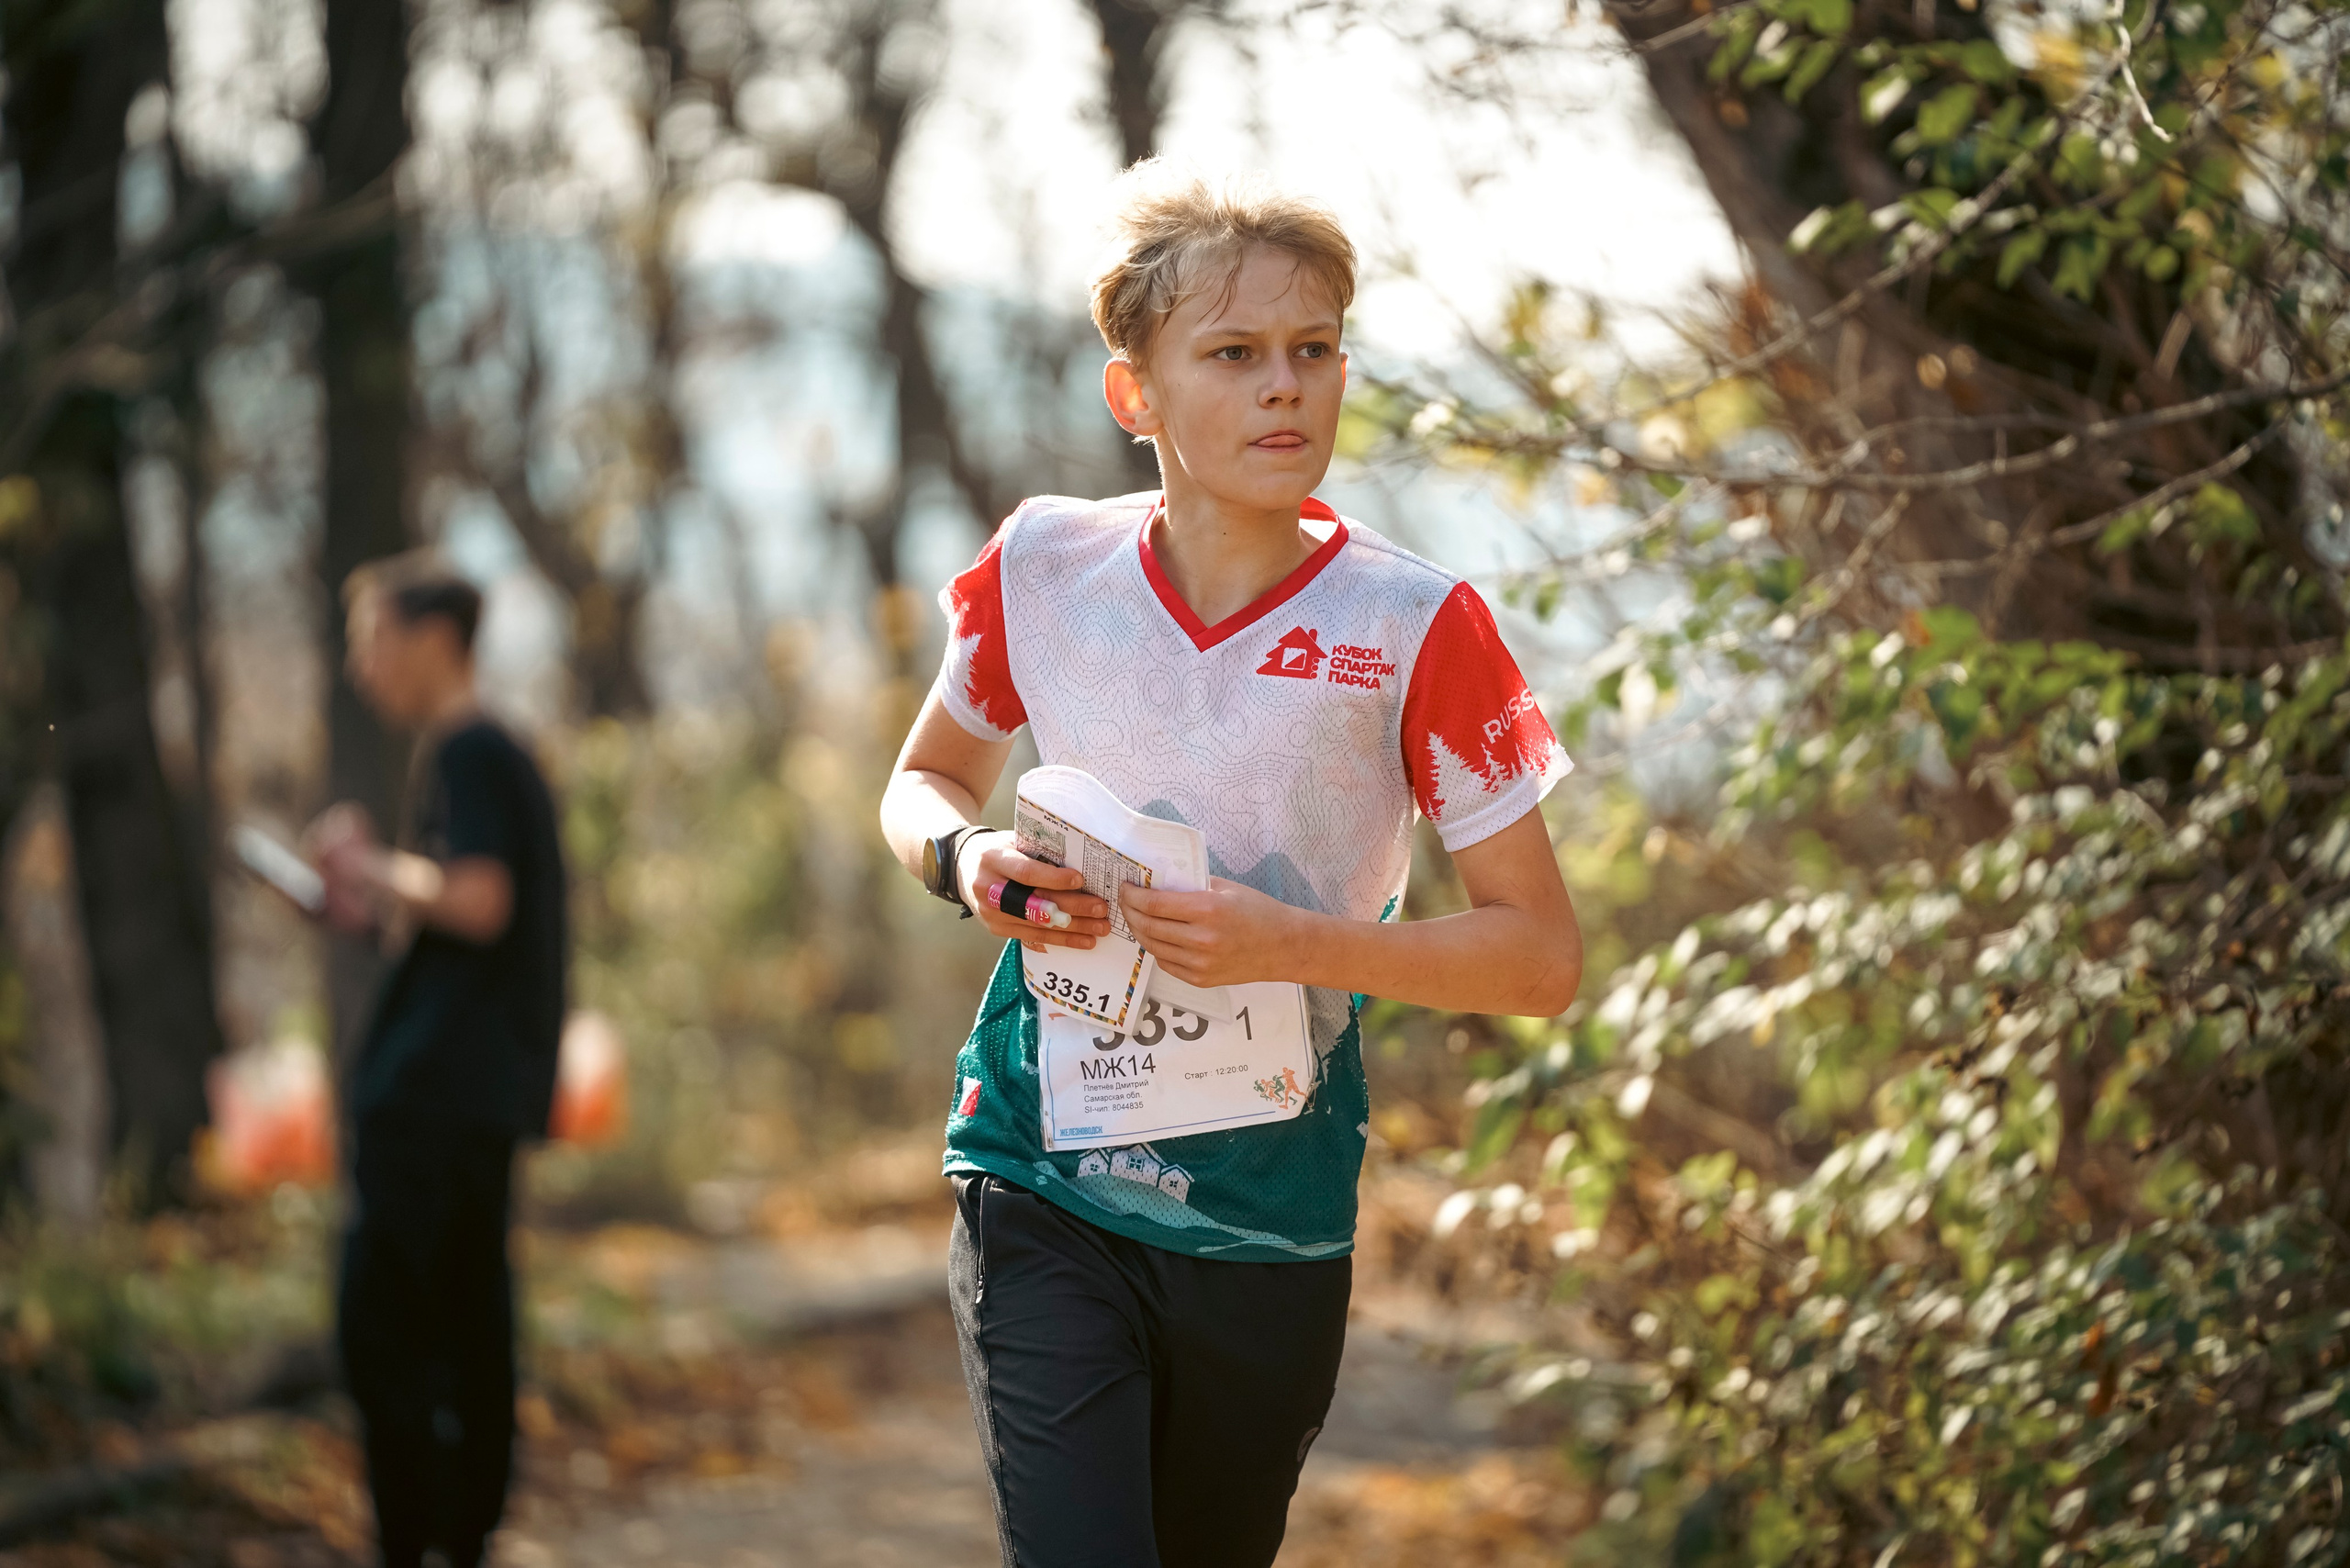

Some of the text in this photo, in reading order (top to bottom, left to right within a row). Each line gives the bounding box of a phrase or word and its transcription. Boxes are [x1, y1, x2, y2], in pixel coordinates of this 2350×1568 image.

[1331, 644, 1382, 661] КУБОК
[1330, 656, 1397, 676] СПАРТАК
[1327, 670, 1381, 689] ПАРКА
[1043, 814, 1069, 832] МЖ14
[1043, 971, 1111, 1013] 335.1
[1236, 1006, 1252, 1040] 1
[1080, 1052, 1157, 1081] МЖ14
[1184, 1071, 1208, 1080] Старт
[1215, 1064, 1248, 1075] 12:20:00
[1115, 1079, 1149, 1091] Дмитрий
[1084, 1091, 1143, 1103] Самарская обл.
[1112, 1102, 1144, 1111] 8044835
